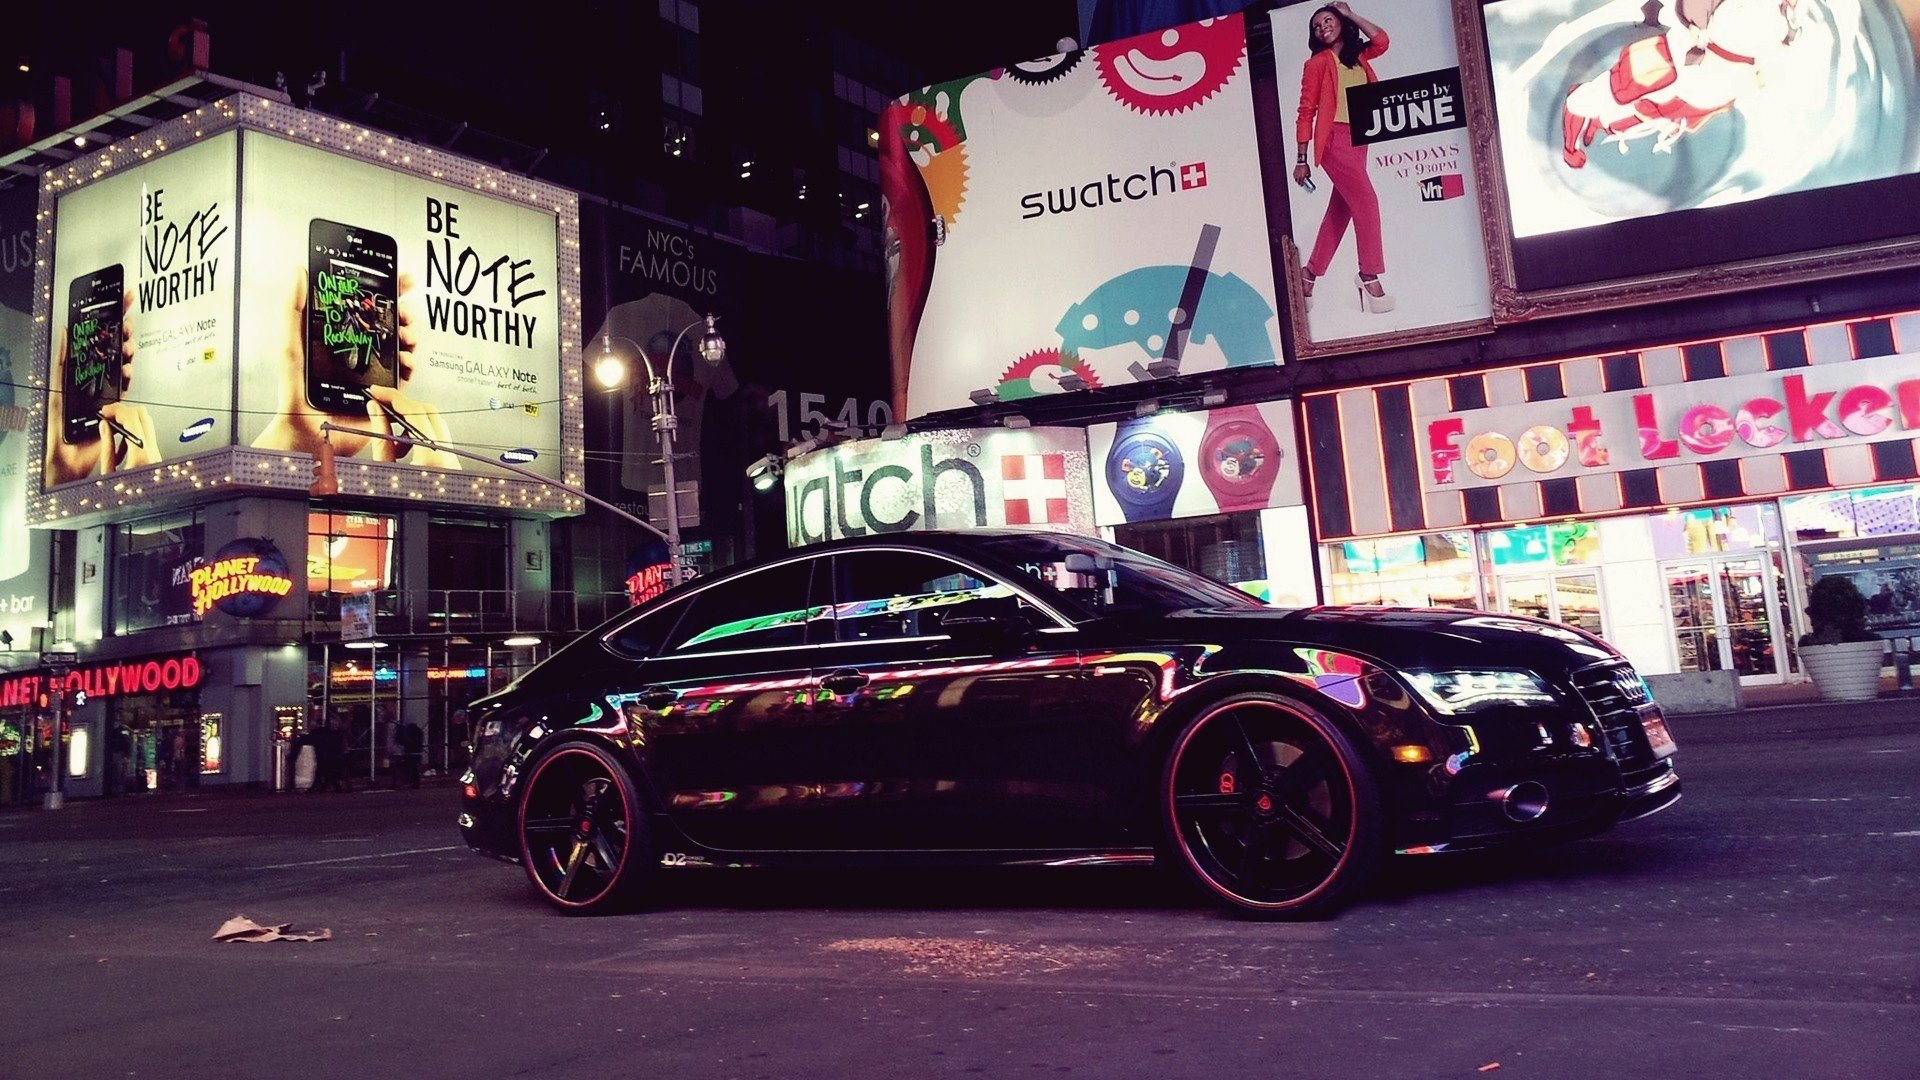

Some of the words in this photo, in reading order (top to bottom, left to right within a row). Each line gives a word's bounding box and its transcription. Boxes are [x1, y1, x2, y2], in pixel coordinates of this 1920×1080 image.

[1382, 89, 1429, 105] STYLED
[1433, 83, 1451, 100] by
[1364, 95, 1456, 137] JUNE
[1375, 143, 1460, 168] MONDAYS
[140, 189, 164, 227] BE
[1021, 165, 1176, 220] swatch
[426, 196, 460, 240] BE
[140, 202, 228, 278] NOTE
[648, 228, 695, 260] NYC's
[139, 257, 218, 314] WORTHY
[426, 237, 547, 309] NOTE
[620, 245, 717, 295] FAMOUS
[197, 318, 217, 332] Note
[324, 306, 341, 324] TO
[425, 294, 537, 349] WORTHY
[429, 357, 464, 374] Samsung
[465, 360, 510, 380] GALAXY
[512, 368, 537, 384] Note
[767, 389, 894, 441] 1540
[1427, 405, 1610, 484] Foot
[190, 557, 259, 597] PLANET
[193, 574, 292, 615] HOLLYWOOD
[10, 594, 35, 614] bar
[0, 676, 43, 706] NET
